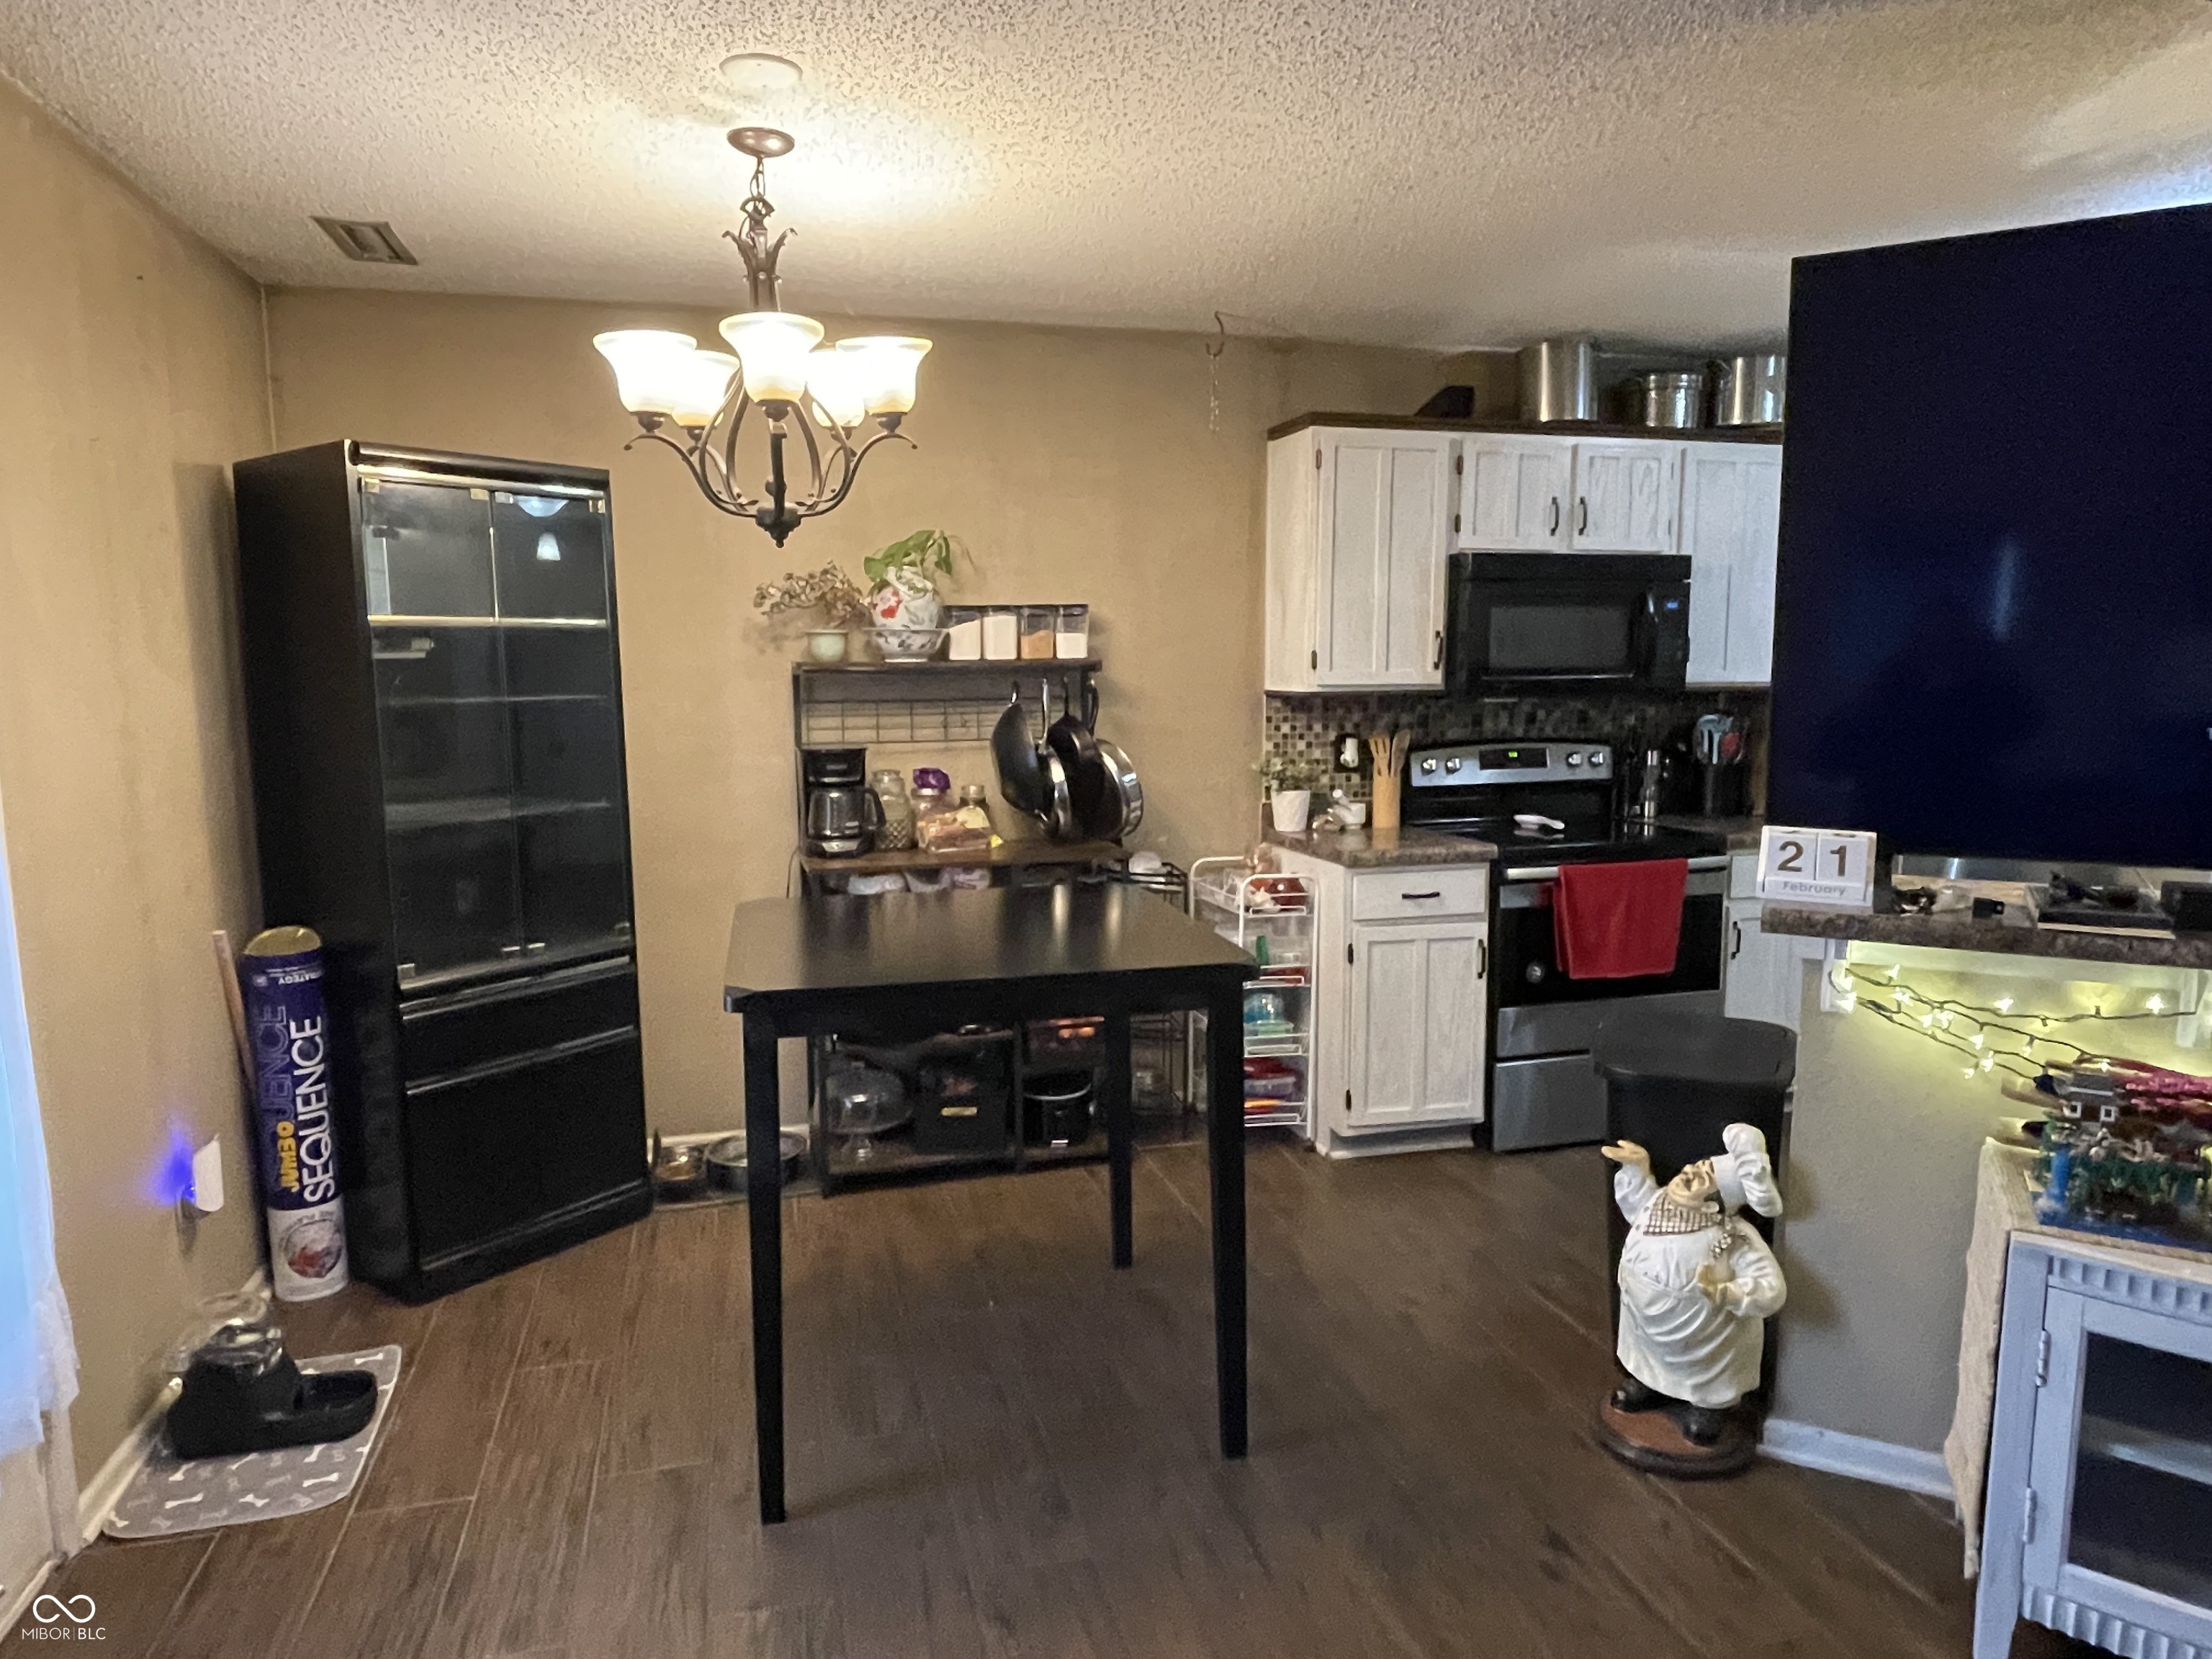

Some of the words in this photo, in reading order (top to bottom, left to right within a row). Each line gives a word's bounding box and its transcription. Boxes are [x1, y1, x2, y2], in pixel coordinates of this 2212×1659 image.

[1782, 881, 1846, 896] February
[289, 1015, 335, 1202] SEQUENCE
[276, 1120, 300, 1193] JUMBO
